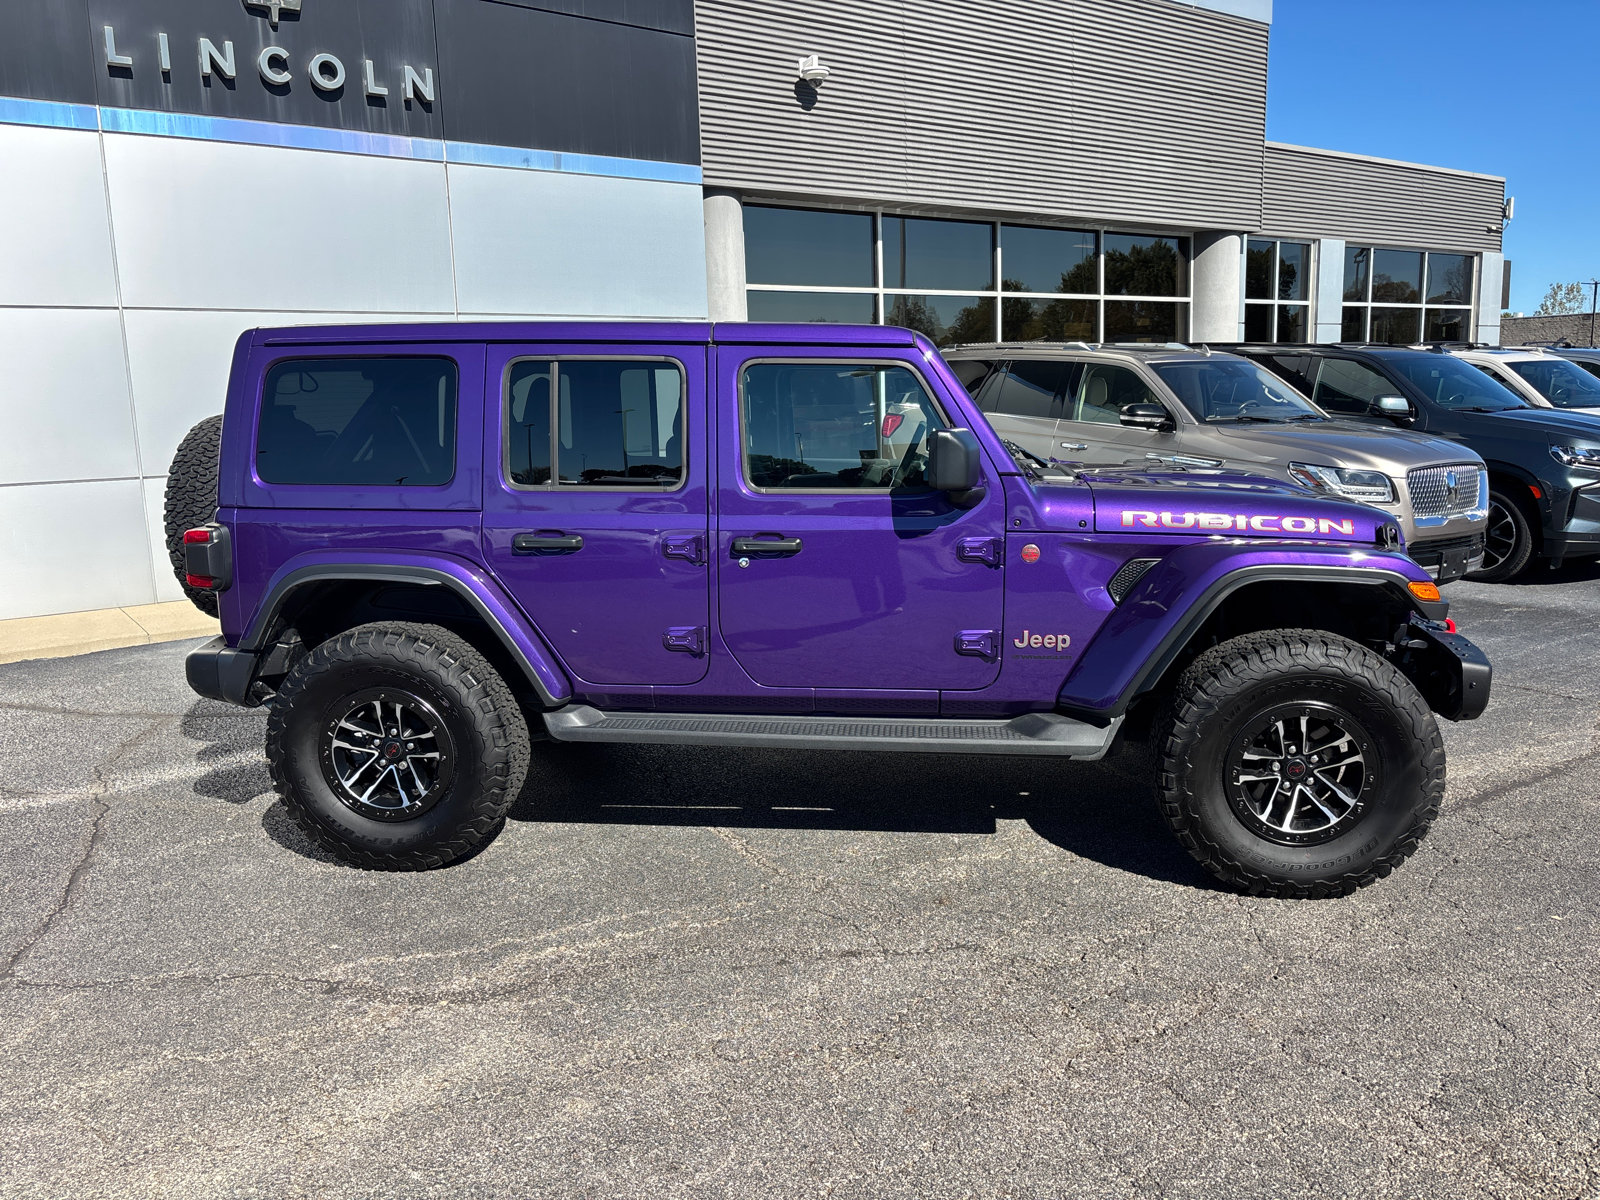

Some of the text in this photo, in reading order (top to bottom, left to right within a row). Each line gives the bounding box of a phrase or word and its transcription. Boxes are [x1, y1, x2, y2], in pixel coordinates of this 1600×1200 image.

[104, 25, 435, 102] LINCOLN
[1121, 510, 1354, 535] RUBICON
[1013, 630, 1071, 652] Jeep
